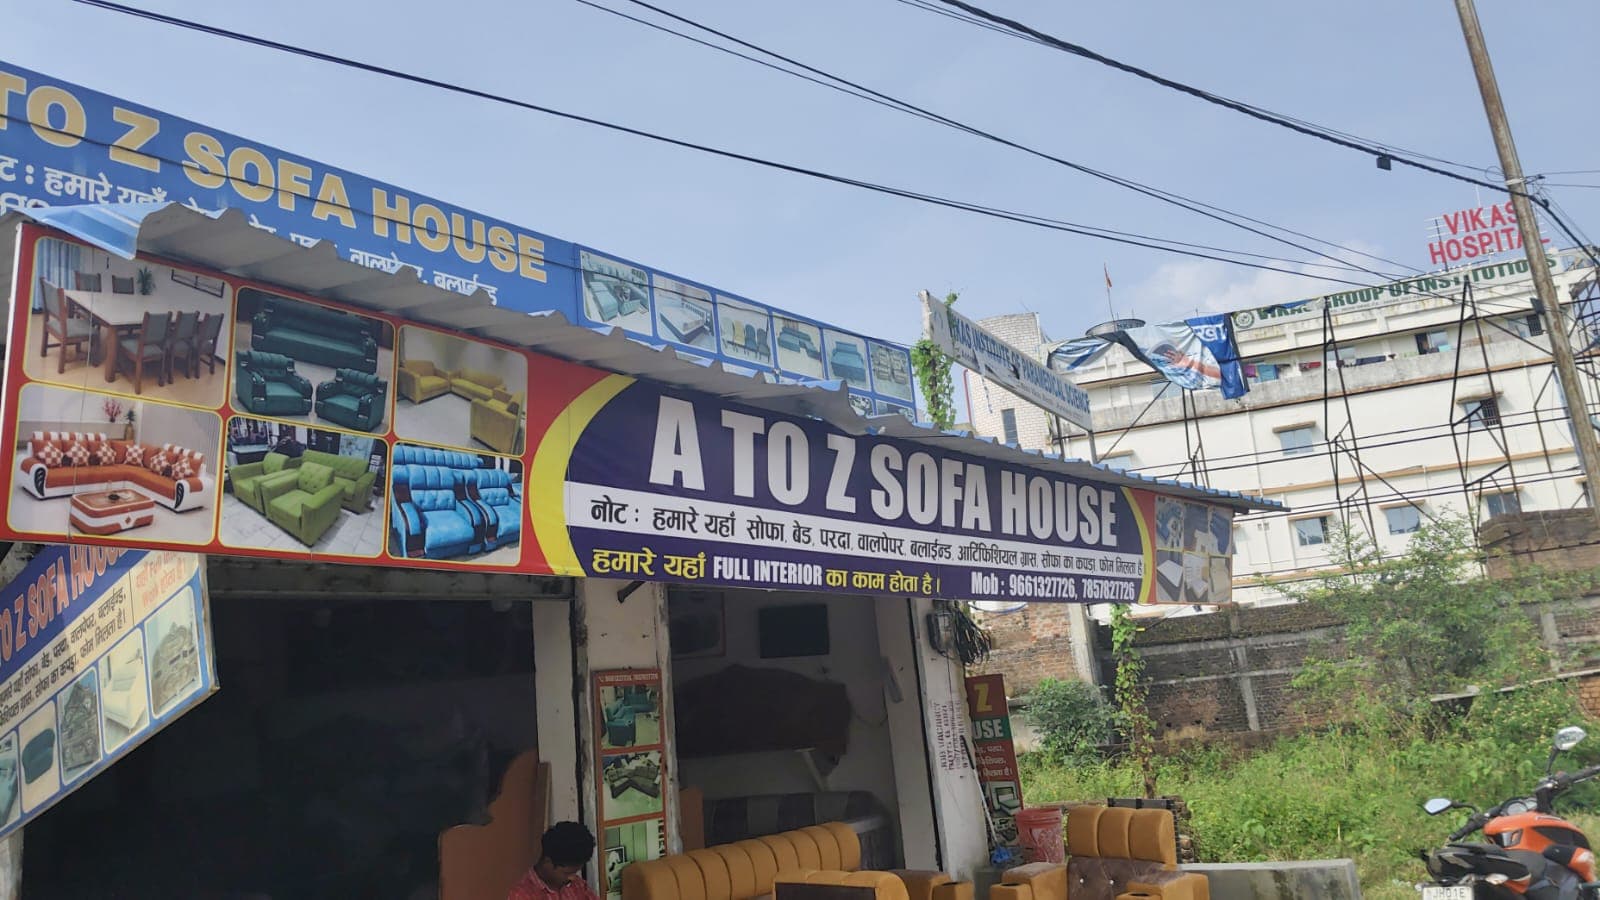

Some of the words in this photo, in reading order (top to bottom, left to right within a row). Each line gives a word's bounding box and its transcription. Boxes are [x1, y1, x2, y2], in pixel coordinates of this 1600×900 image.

[109, 106, 160, 173] Z
[182, 131, 356, 229] SOFA
[371, 187, 547, 284] HOUSE
[1443, 200, 1519, 236] VIKAS
[1428, 226, 1551, 265] HOSPIT
[649, 395, 705, 491] A
[721, 409, 809, 506] TO
[826, 433, 856, 513] Z
[870, 443, 992, 532] SOFA
[1001, 470, 1118, 547] HOUSE
[653, 506, 699, 533] हमारे
[1041, 550, 1061, 568] सोफा
[1063, 555, 1073, 569] का
[592, 546, 658, 576] हमारे
[713, 555, 751, 581] FULL
[753, 559, 822, 586] INTERIOR
[825, 568, 848, 588] का
[852, 571, 885, 591] काम
[889, 570, 919, 593] होता
[1009, 573, 1078, 600] 9661327726,
[1082, 578, 1136, 600] 7857827726
[14, 593, 27, 652] Z
[27, 555, 70, 638] SOFA
[974, 683, 992, 712] Z
